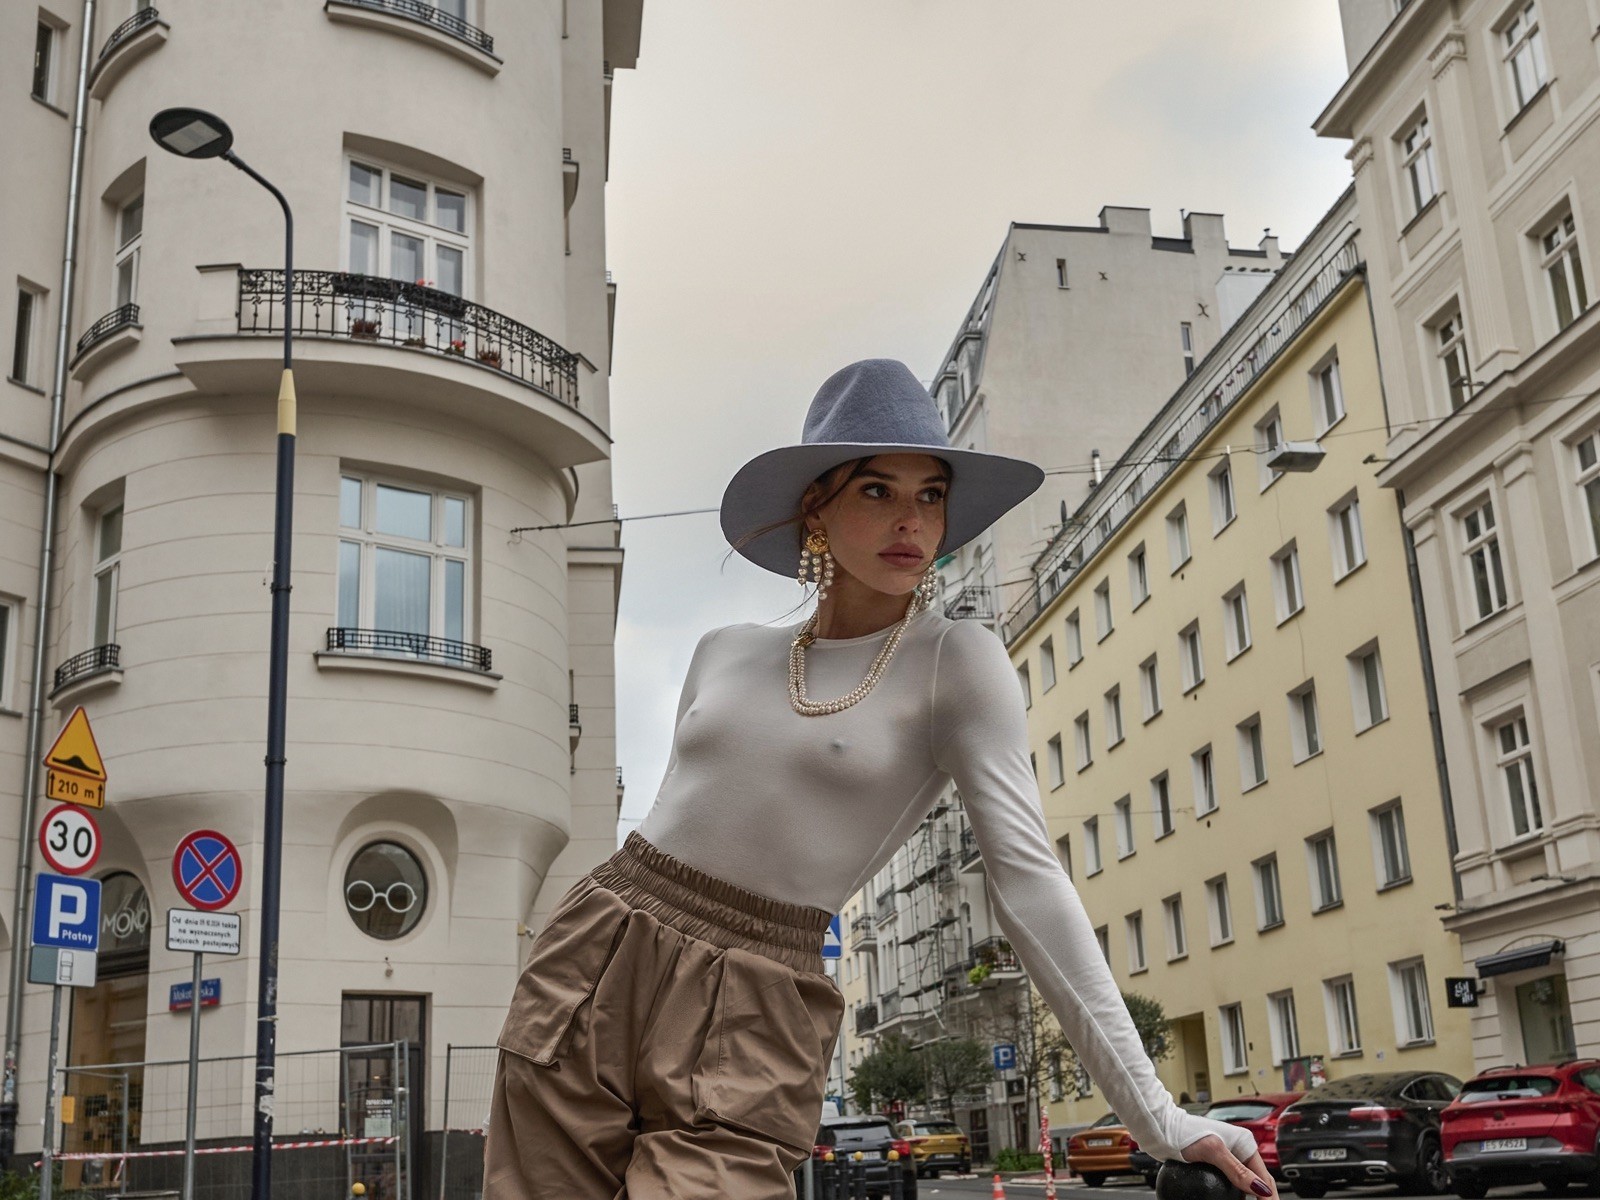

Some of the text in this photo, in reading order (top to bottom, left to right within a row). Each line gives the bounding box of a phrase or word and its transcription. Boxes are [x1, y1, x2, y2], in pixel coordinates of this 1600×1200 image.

[59, 780, 95, 799] 210 m
[50, 820, 93, 858] 30
[48, 882, 87, 938] P
[172, 916, 181, 924] Od
[62, 929, 93, 944] Płatny
[173, 986, 214, 1000] Mokotska
[1000, 1048, 1011, 1066] P
